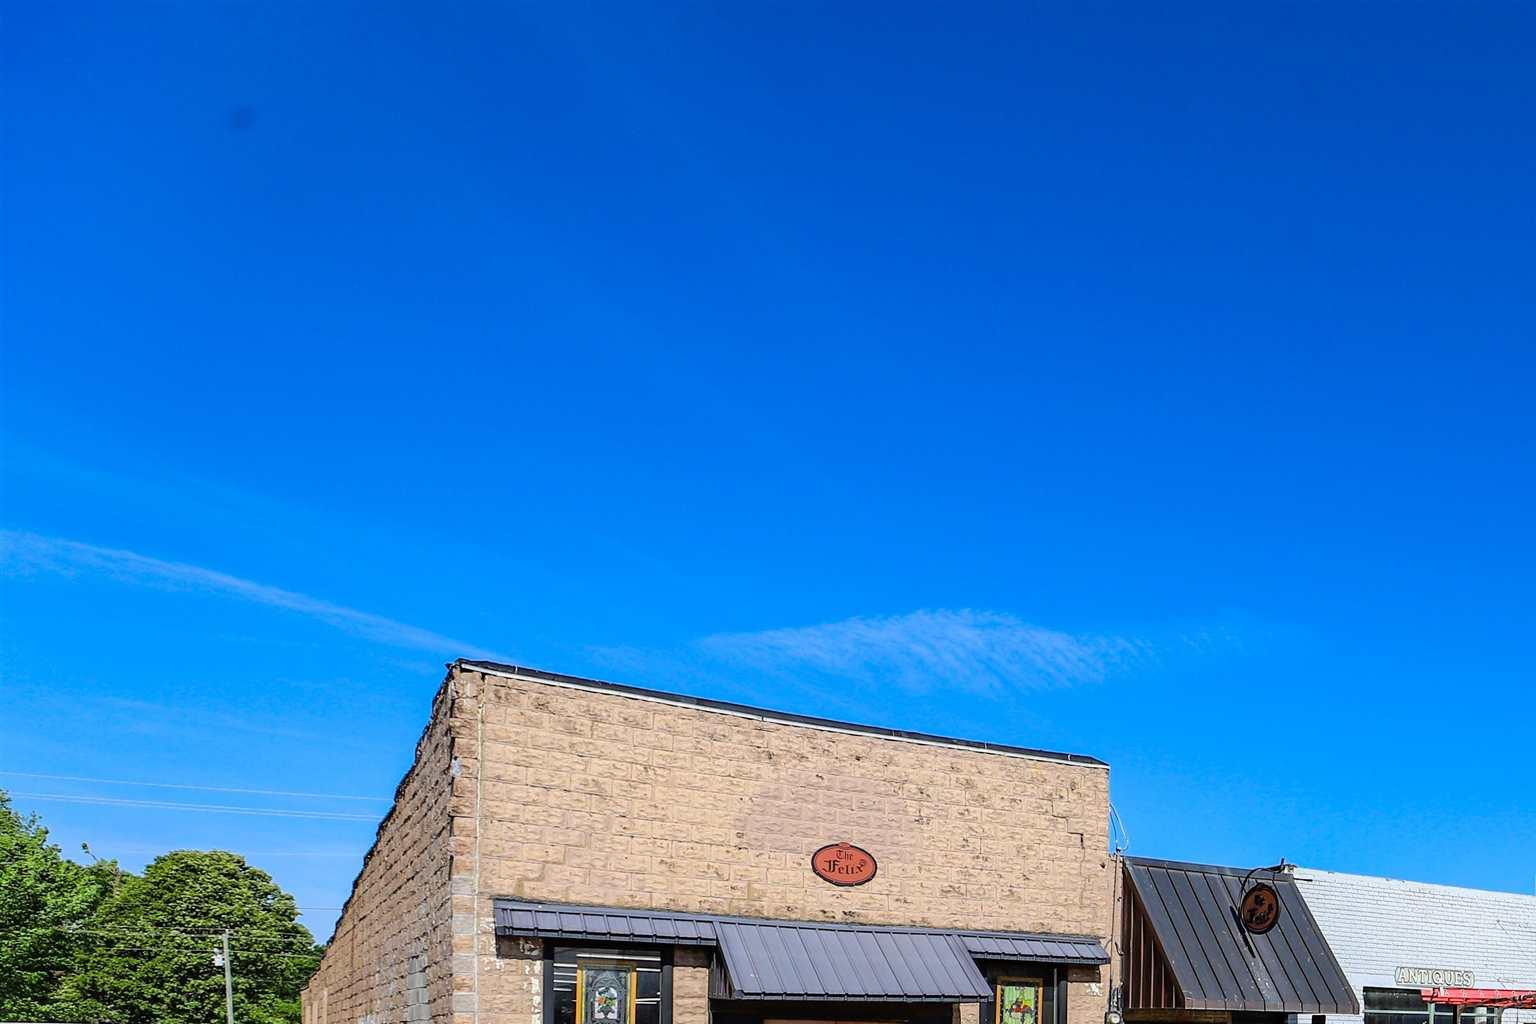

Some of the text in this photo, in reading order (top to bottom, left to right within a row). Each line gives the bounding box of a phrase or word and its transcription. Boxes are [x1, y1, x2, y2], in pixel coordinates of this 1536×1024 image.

[836, 850, 853, 860] The
[822, 860, 865, 874] Felix
[1398, 967, 1473, 987] ANTIQUES
